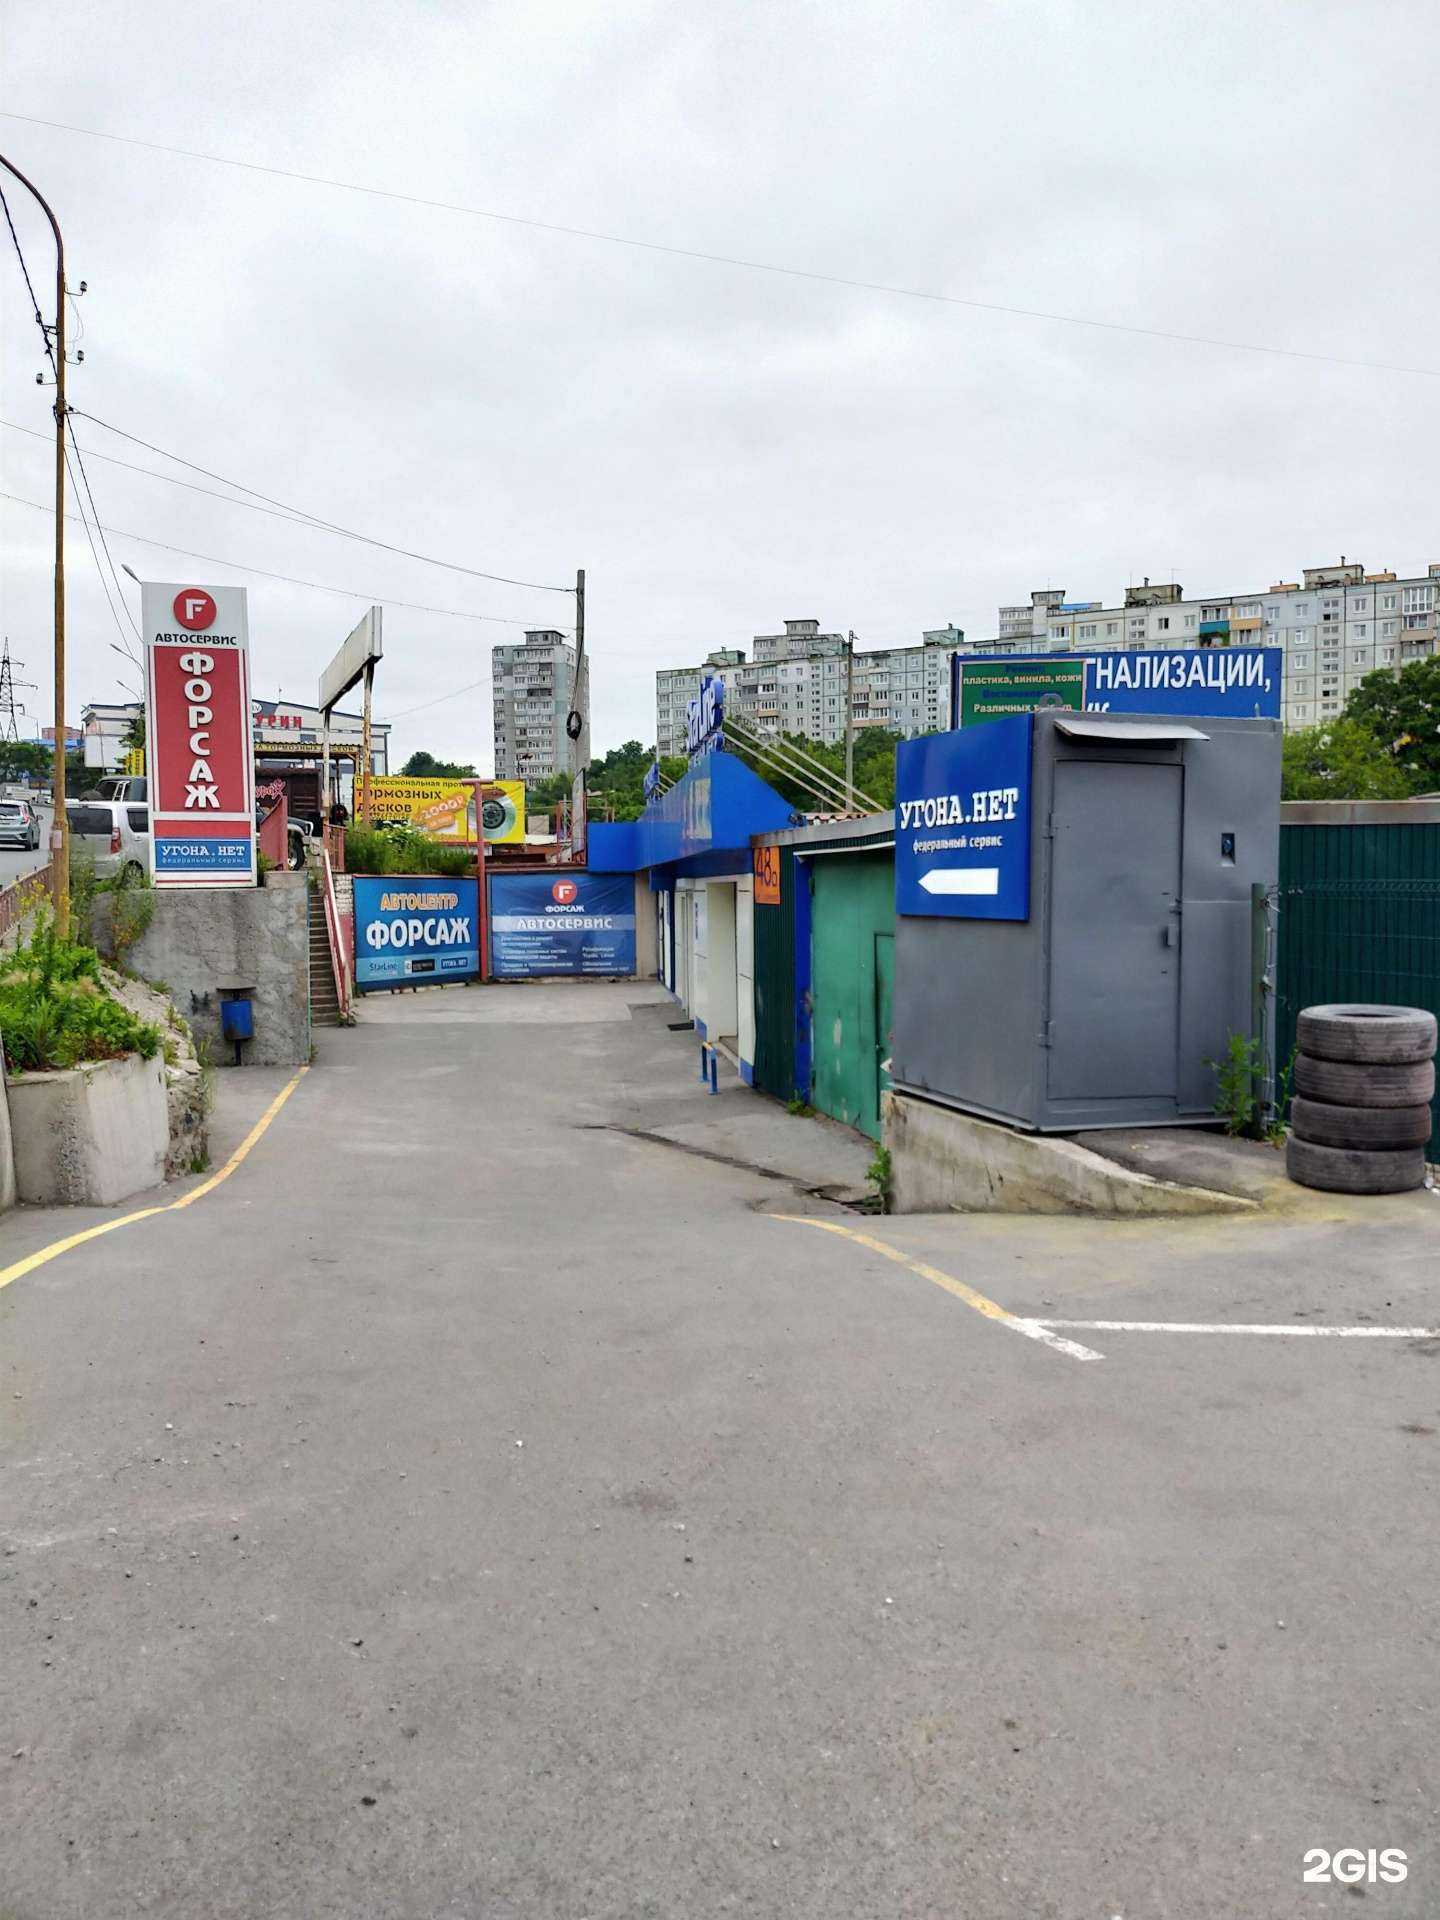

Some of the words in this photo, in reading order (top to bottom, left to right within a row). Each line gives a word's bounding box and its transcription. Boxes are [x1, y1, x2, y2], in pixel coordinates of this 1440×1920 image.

[155, 633, 238, 646] АВТОСЕРВИС
[963, 675, 1013, 686] пластика,
[1055, 673, 1083, 683] кожи
[973, 703, 1031, 713] Различных
[179, 651, 221, 809] ФОРСАЖ
[900, 788, 1018, 830] УГОНА.НЕТ
[912, 835, 967, 855] федеральный
[969, 835, 1003, 850] сервис
[380, 893, 459, 911] АВТОЦЕНТР
[545, 904, 585, 913] ФОРСАЖ
[517, 918, 613, 930] АВТОСЕРВИС
[366, 917, 470, 950] ФОРСАЖ
